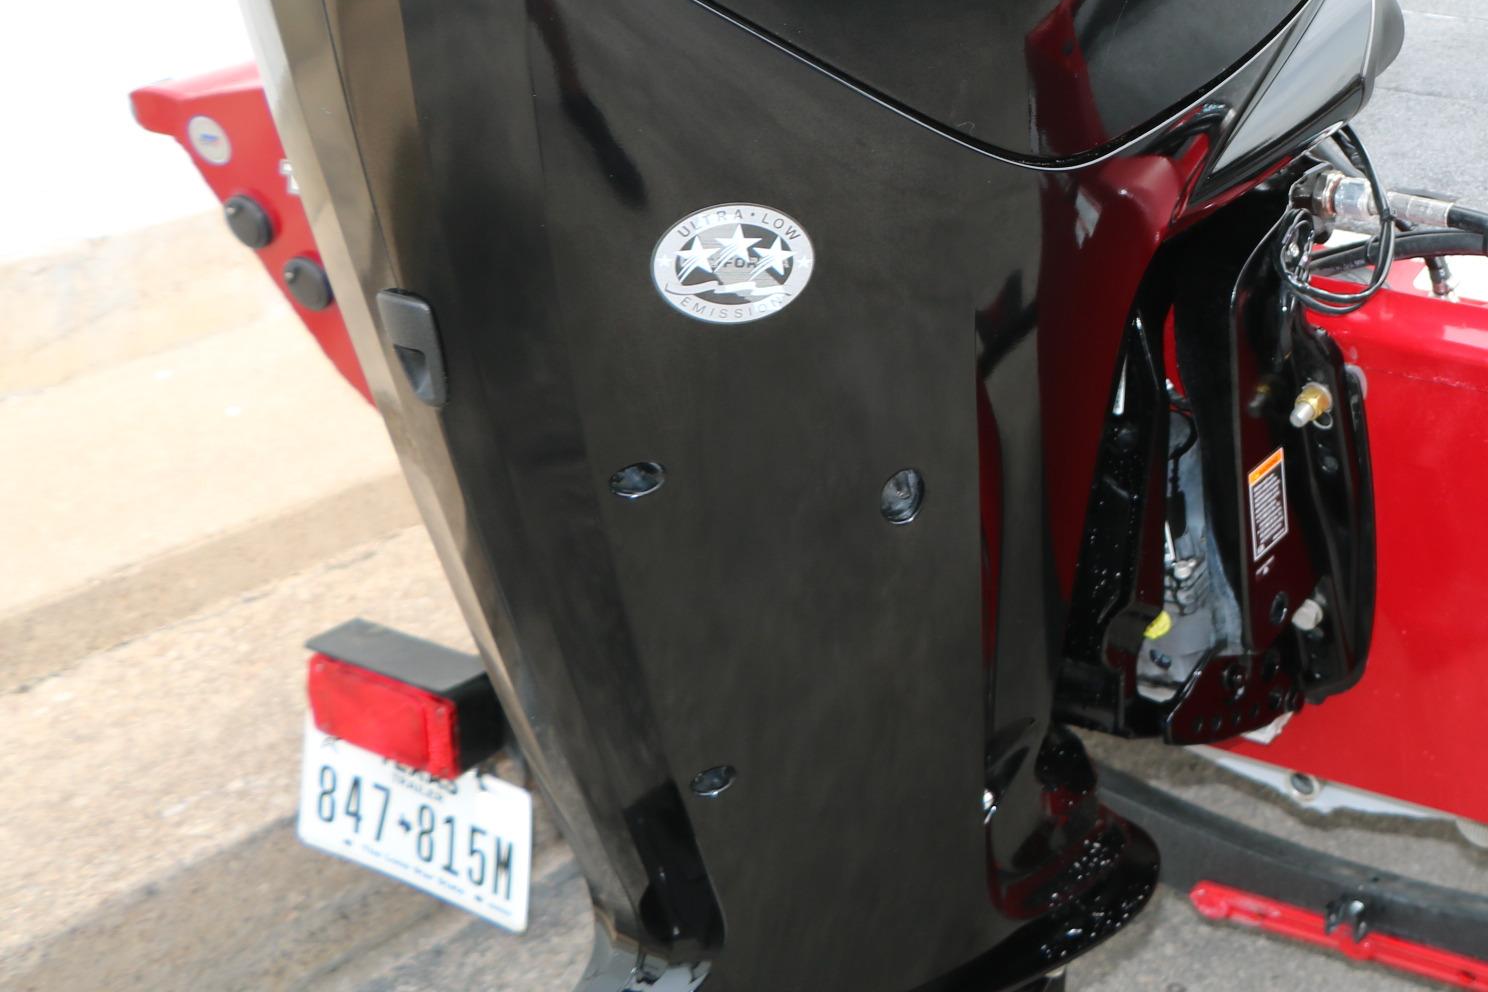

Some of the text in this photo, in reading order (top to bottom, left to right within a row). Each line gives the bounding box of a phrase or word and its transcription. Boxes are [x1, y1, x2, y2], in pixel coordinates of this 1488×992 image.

[677, 208, 802, 241] ULTRA LOW
[317, 762, 391, 842] 847
[415, 802, 514, 901] 815M
